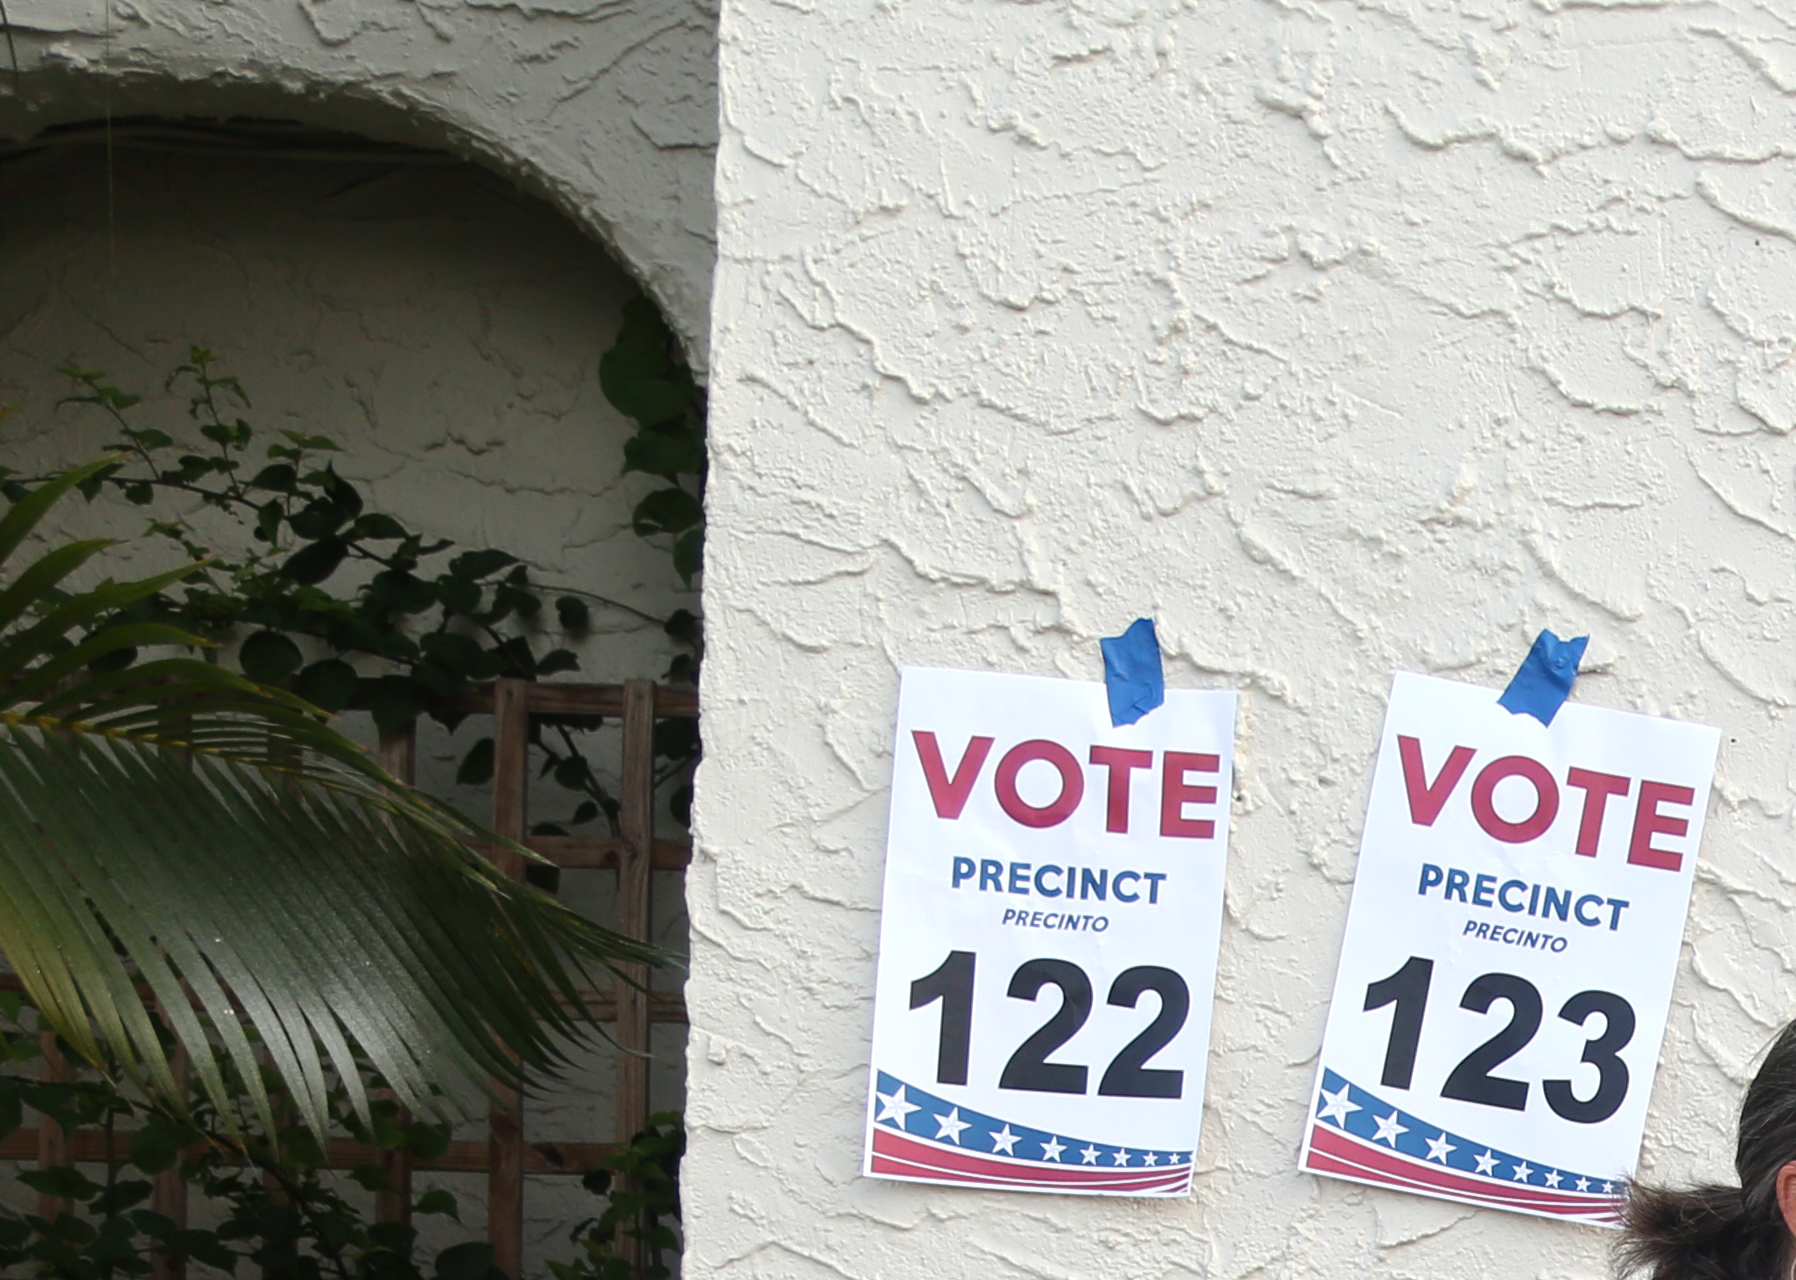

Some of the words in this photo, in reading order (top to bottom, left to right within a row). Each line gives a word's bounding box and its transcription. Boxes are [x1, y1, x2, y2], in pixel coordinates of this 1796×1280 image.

[912, 730, 1220, 839] VOTE
[1397, 733, 1696, 873] VOTE
[951, 855, 1167, 906] PRECINCT
[1001, 907, 1110, 934] PRECINTO
[1417, 862, 1630, 932] PRECINCT
[1462, 919, 1569, 954] PRECINTO
[908, 950, 1191, 1100] 122
[1361, 955, 1637, 1125] 123
